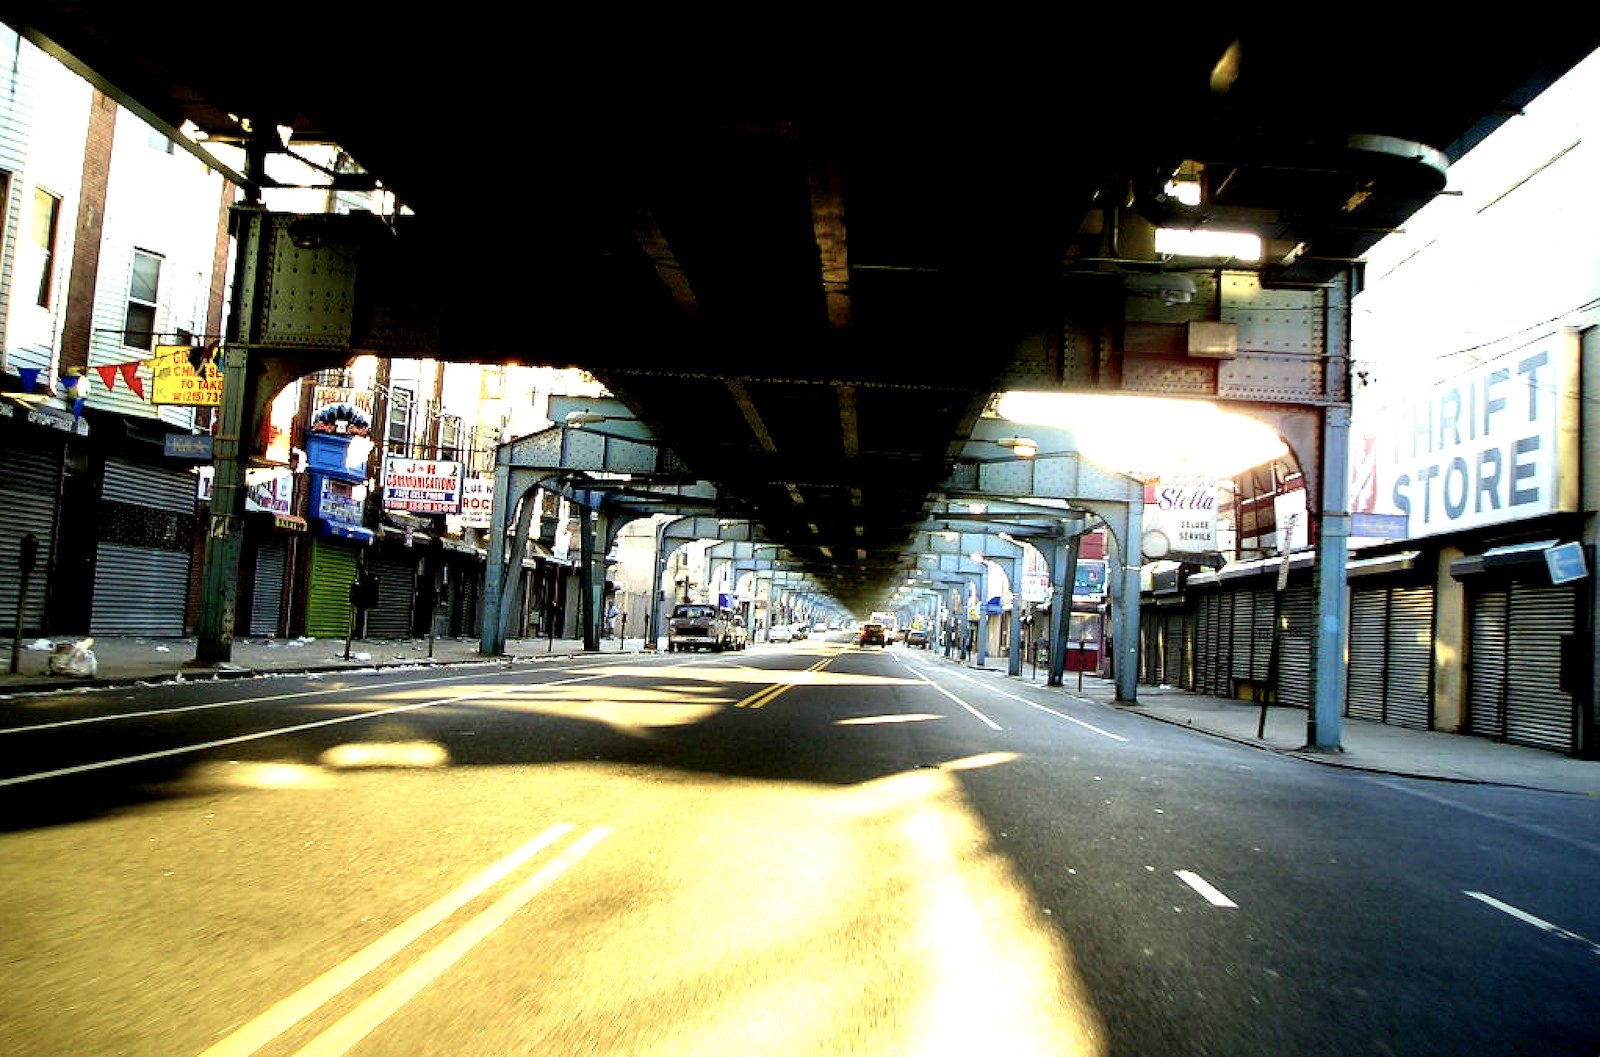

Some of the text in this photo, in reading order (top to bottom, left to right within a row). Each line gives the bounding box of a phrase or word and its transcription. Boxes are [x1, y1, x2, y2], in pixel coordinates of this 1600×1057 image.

[181, 380, 194, 389] TO
[1392, 435, 1540, 524] STORE
[1159, 487, 1214, 511] Stella
[1179, 531, 1211, 541] SERVICE
